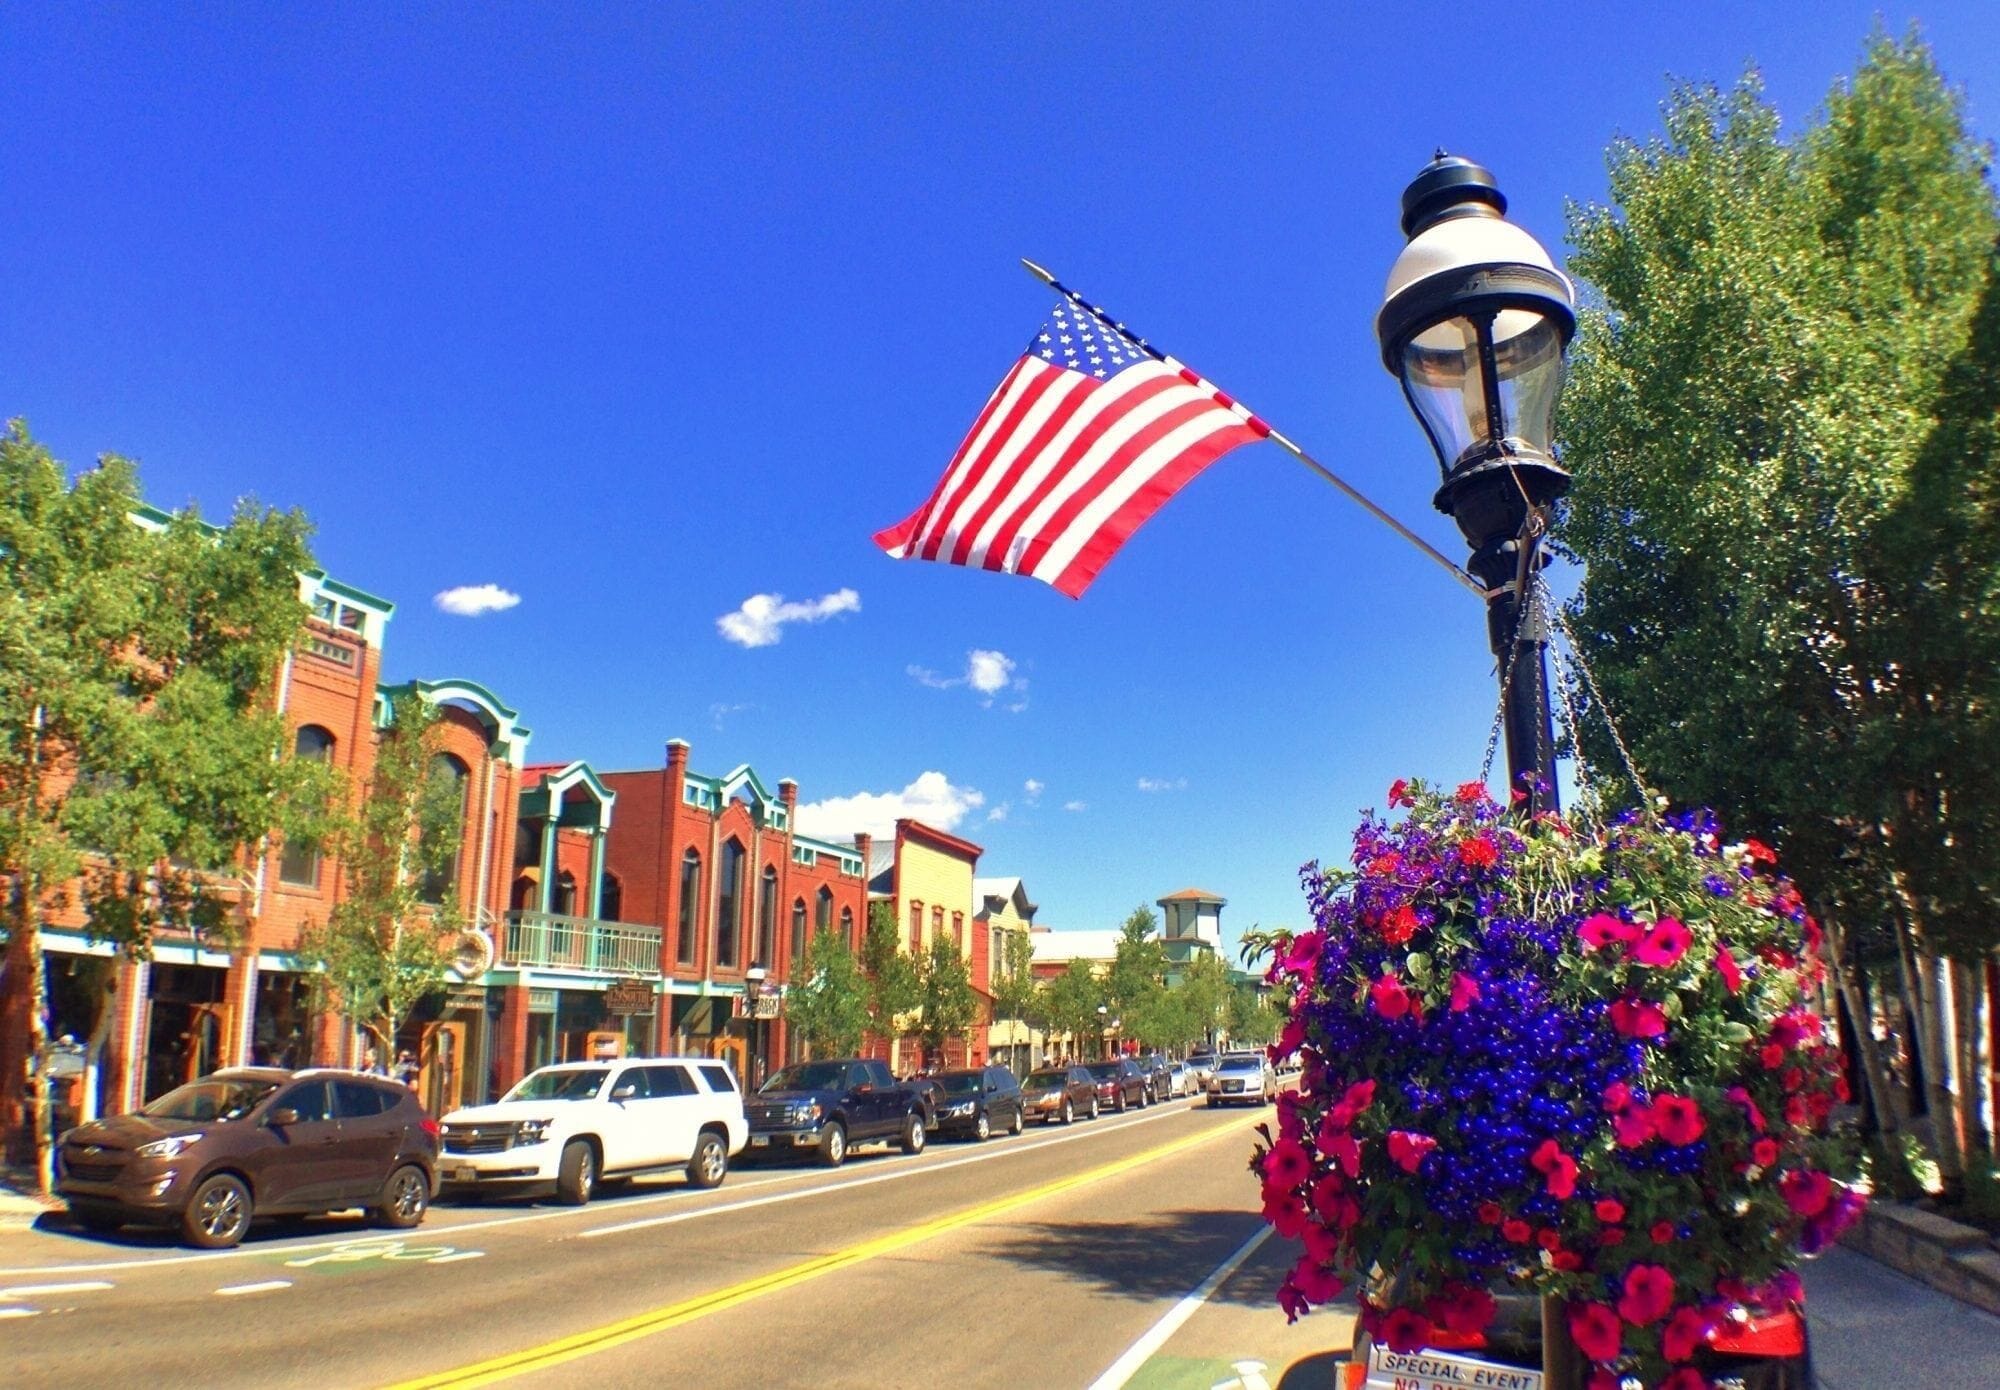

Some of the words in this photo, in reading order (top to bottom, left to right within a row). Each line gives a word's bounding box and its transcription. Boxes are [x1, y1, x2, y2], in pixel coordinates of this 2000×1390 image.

[1385, 1355, 1463, 1380] SPECIAL
[1474, 1370, 1532, 1390] EVENT
[1394, 1377, 1420, 1390] NO
